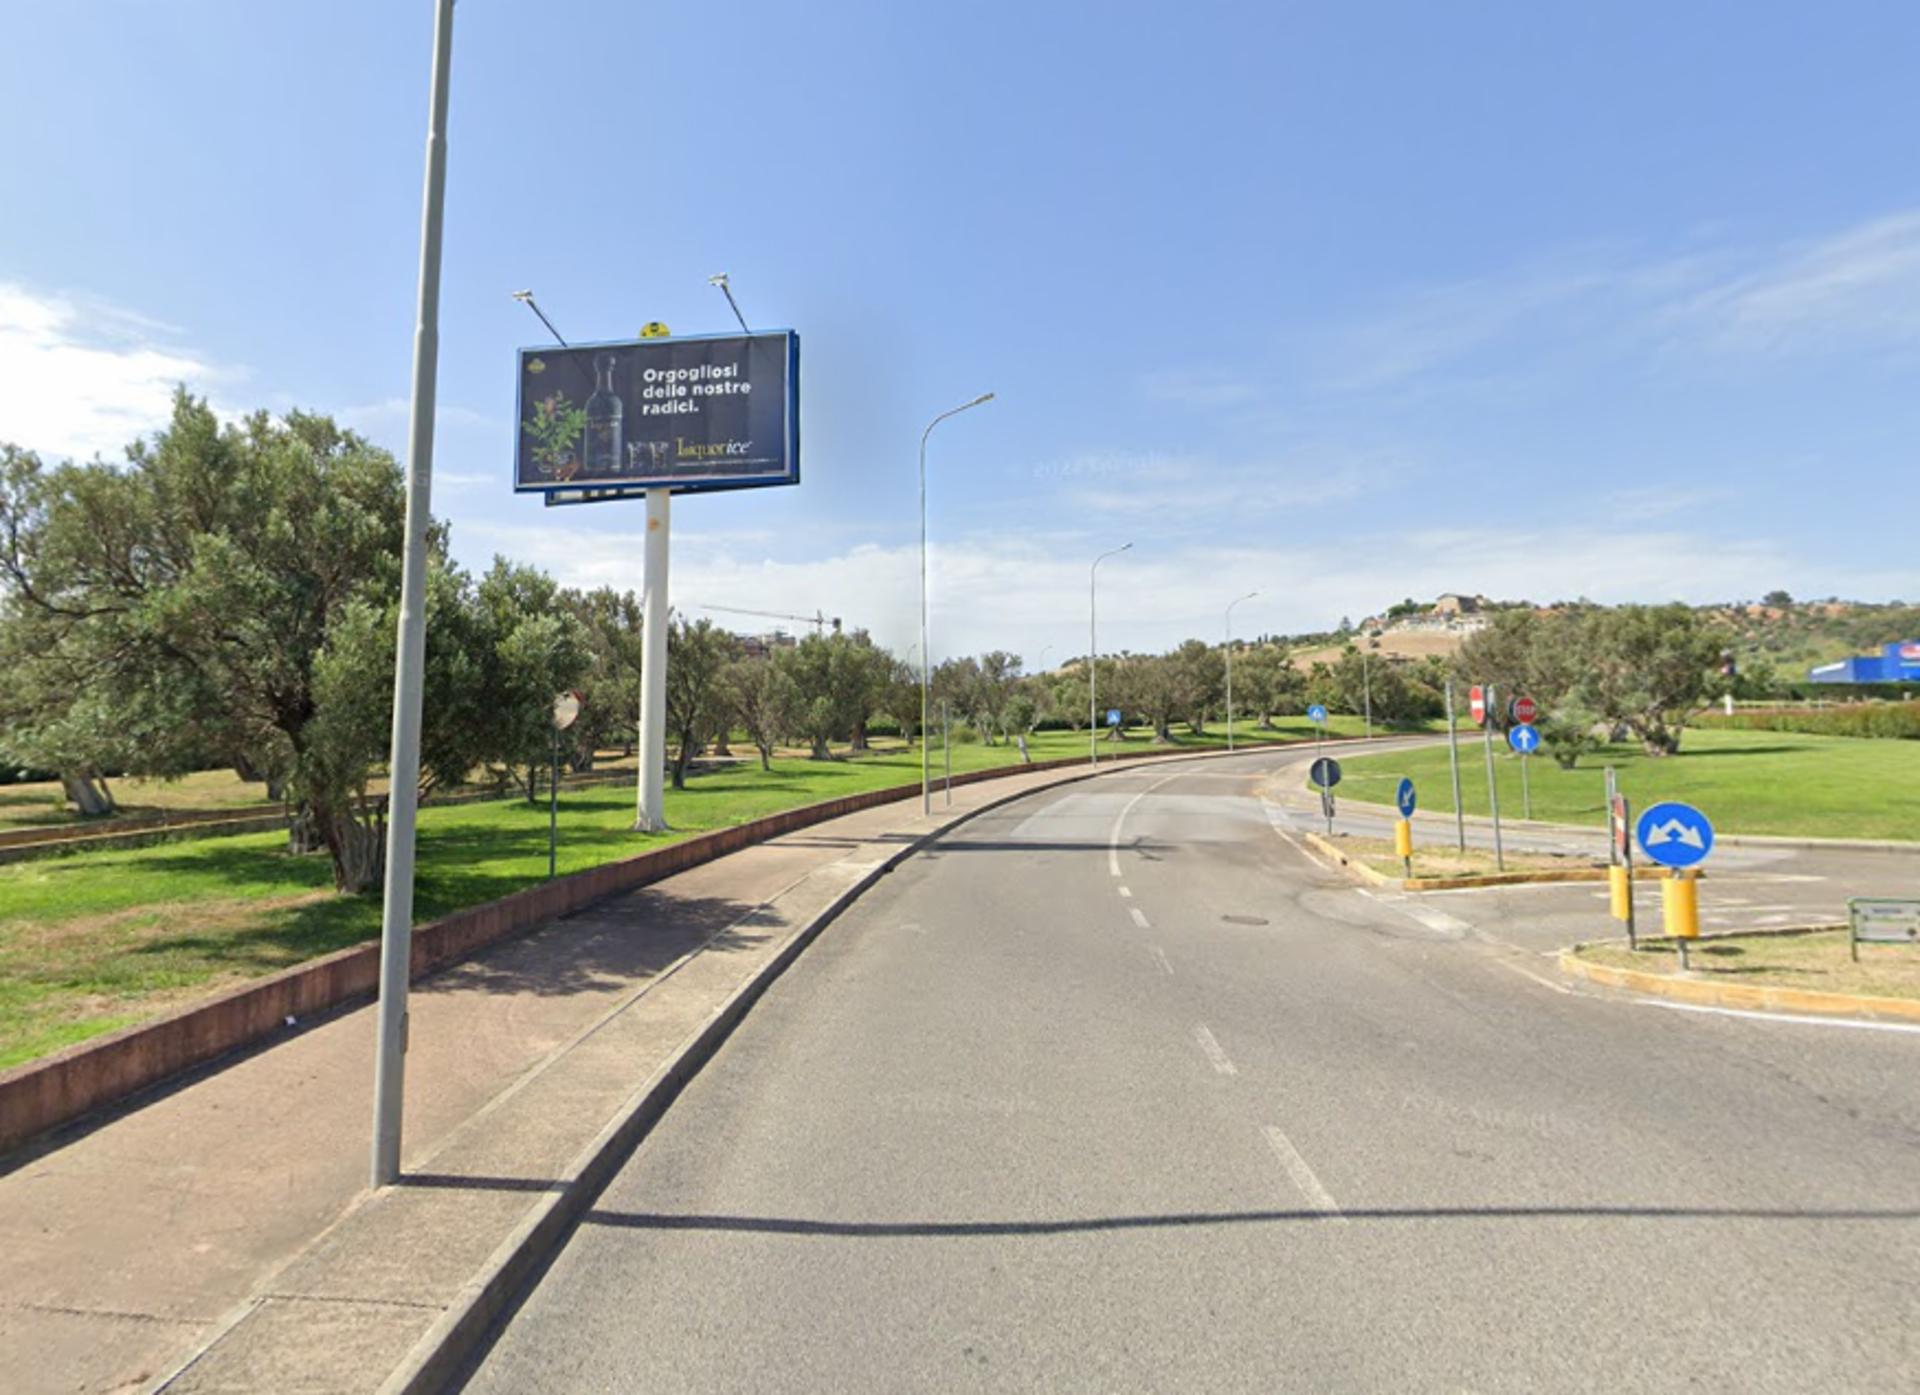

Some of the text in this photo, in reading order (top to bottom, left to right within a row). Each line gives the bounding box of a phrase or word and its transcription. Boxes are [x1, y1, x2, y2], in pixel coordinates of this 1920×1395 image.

[643, 363, 737, 383] Orgogliosi
[643, 381, 752, 399] delle nostre
[642, 399, 699, 415] radici.
[1514, 704, 1536, 715] STOP
